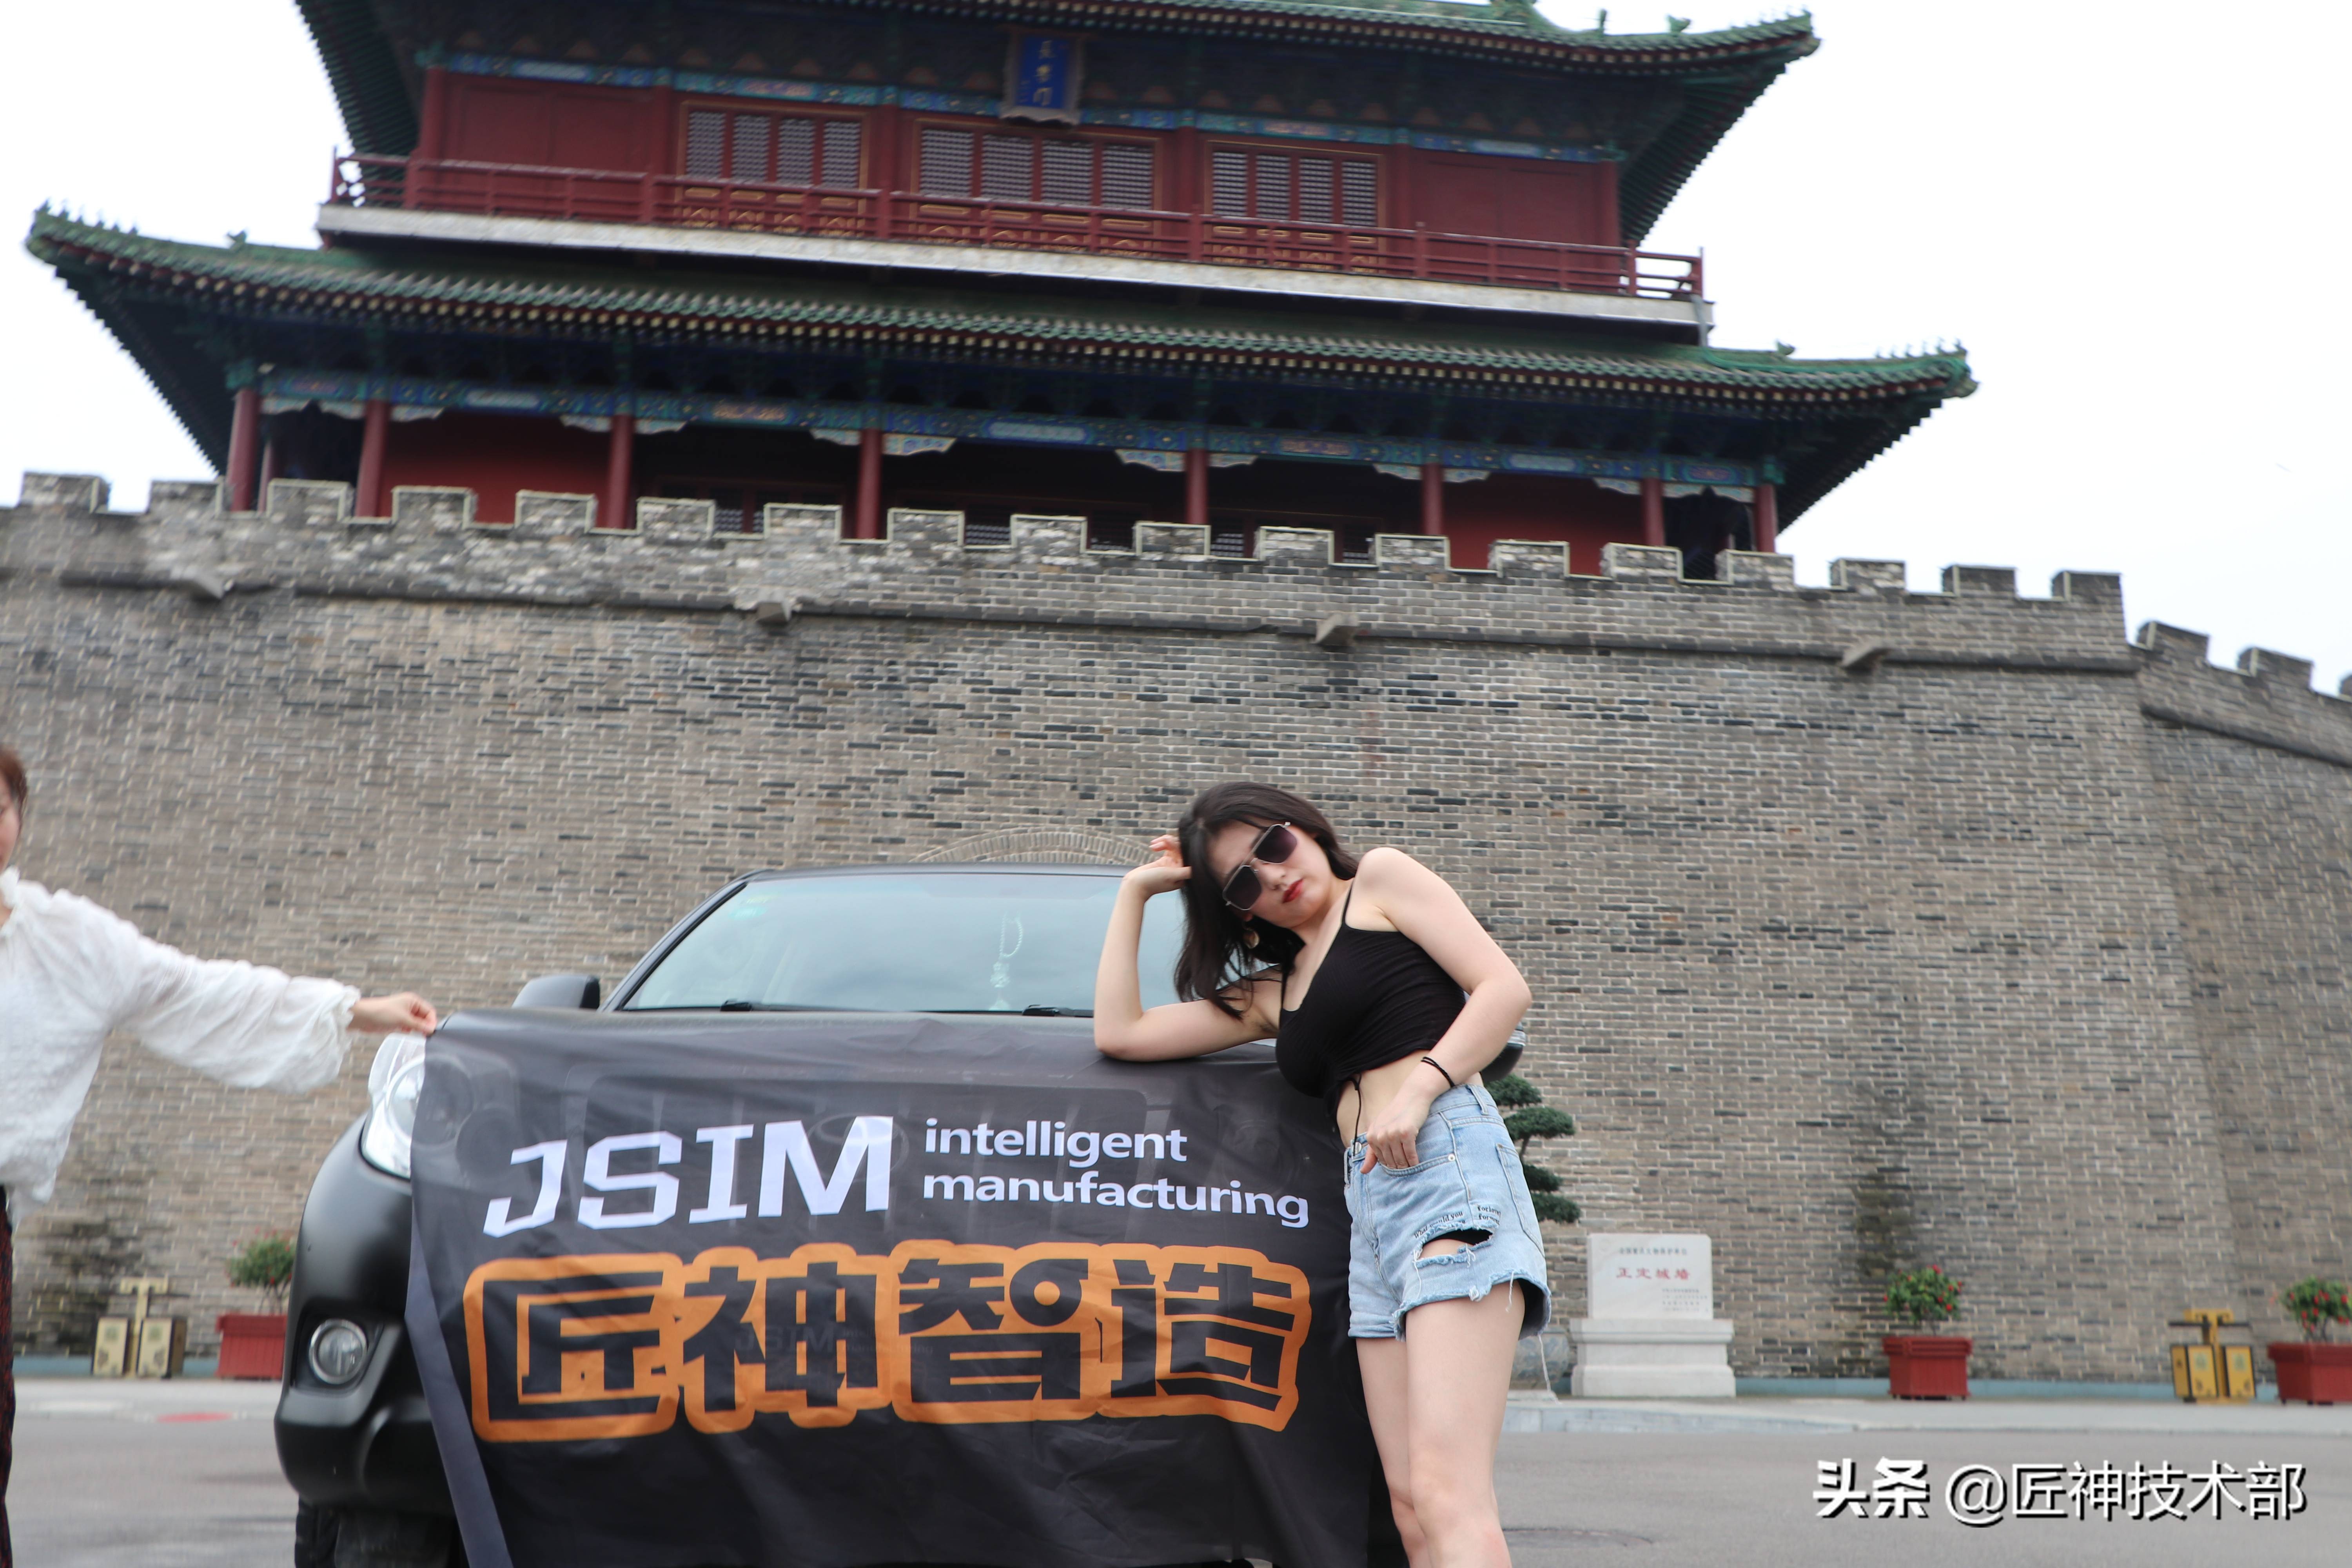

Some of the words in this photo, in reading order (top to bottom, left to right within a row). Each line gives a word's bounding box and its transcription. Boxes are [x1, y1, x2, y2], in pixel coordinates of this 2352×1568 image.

[926, 1118, 1187, 1165] intelligent
[484, 1116, 893, 1236] JSIM
[924, 1164, 1308, 1227] manufacturing
[1616, 1267, 1690, 1280] 正定城墙
[464, 1240, 1312, 1442] 匠神智造
